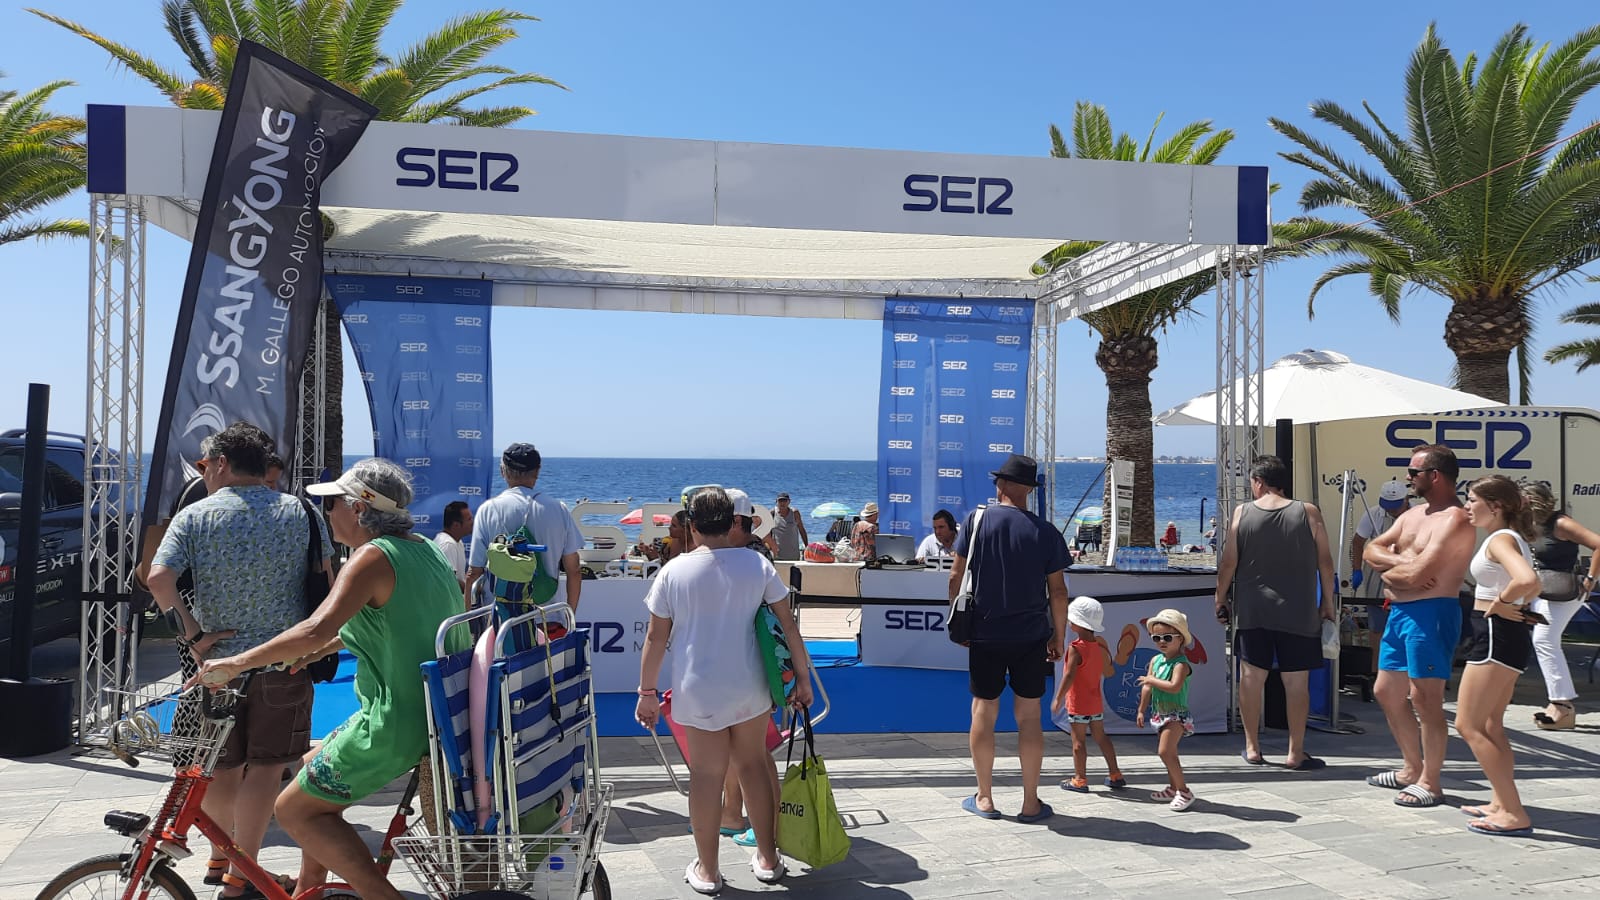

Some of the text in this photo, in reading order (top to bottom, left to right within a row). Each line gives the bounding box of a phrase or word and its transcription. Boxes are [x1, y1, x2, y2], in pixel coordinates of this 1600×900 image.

[396, 146, 520, 193] SER
[902, 173, 1014, 215] SER
[197, 106, 296, 389] SSANGYONG
[395, 285, 424, 295] SER
[946, 305, 972, 316] SER
[261, 267, 300, 365] GALLEGO
[455, 316, 482, 327] SER
[894, 332, 918, 343] SER
[995, 335, 1021, 345] SER
[400, 342, 428, 352] SER
[942, 360, 967, 370] SER
[993, 362, 1018, 372] SER
[456, 373, 483, 383] SER
[256, 372, 276, 395] M.
[890, 386, 915, 396] SER
[991, 389, 1016, 399] SER
[403, 400, 430, 410] SER
[939, 414, 965, 424] SER
[457, 429, 482, 440] SER
[888, 439, 913, 450] SER
[988, 443, 1013, 453] SER
[405, 457, 431, 468] SER
[938, 468, 963, 478] SER
[458, 486, 482, 496] SER
[1572, 483, 1600, 496] Radi
[889, 493, 911, 503] SER
[411, 514, 431, 524] ER
[924, 555, 956, 573] SE
[885, 609, 945, 632] SER
[779, 801, 804, 817] ankia
